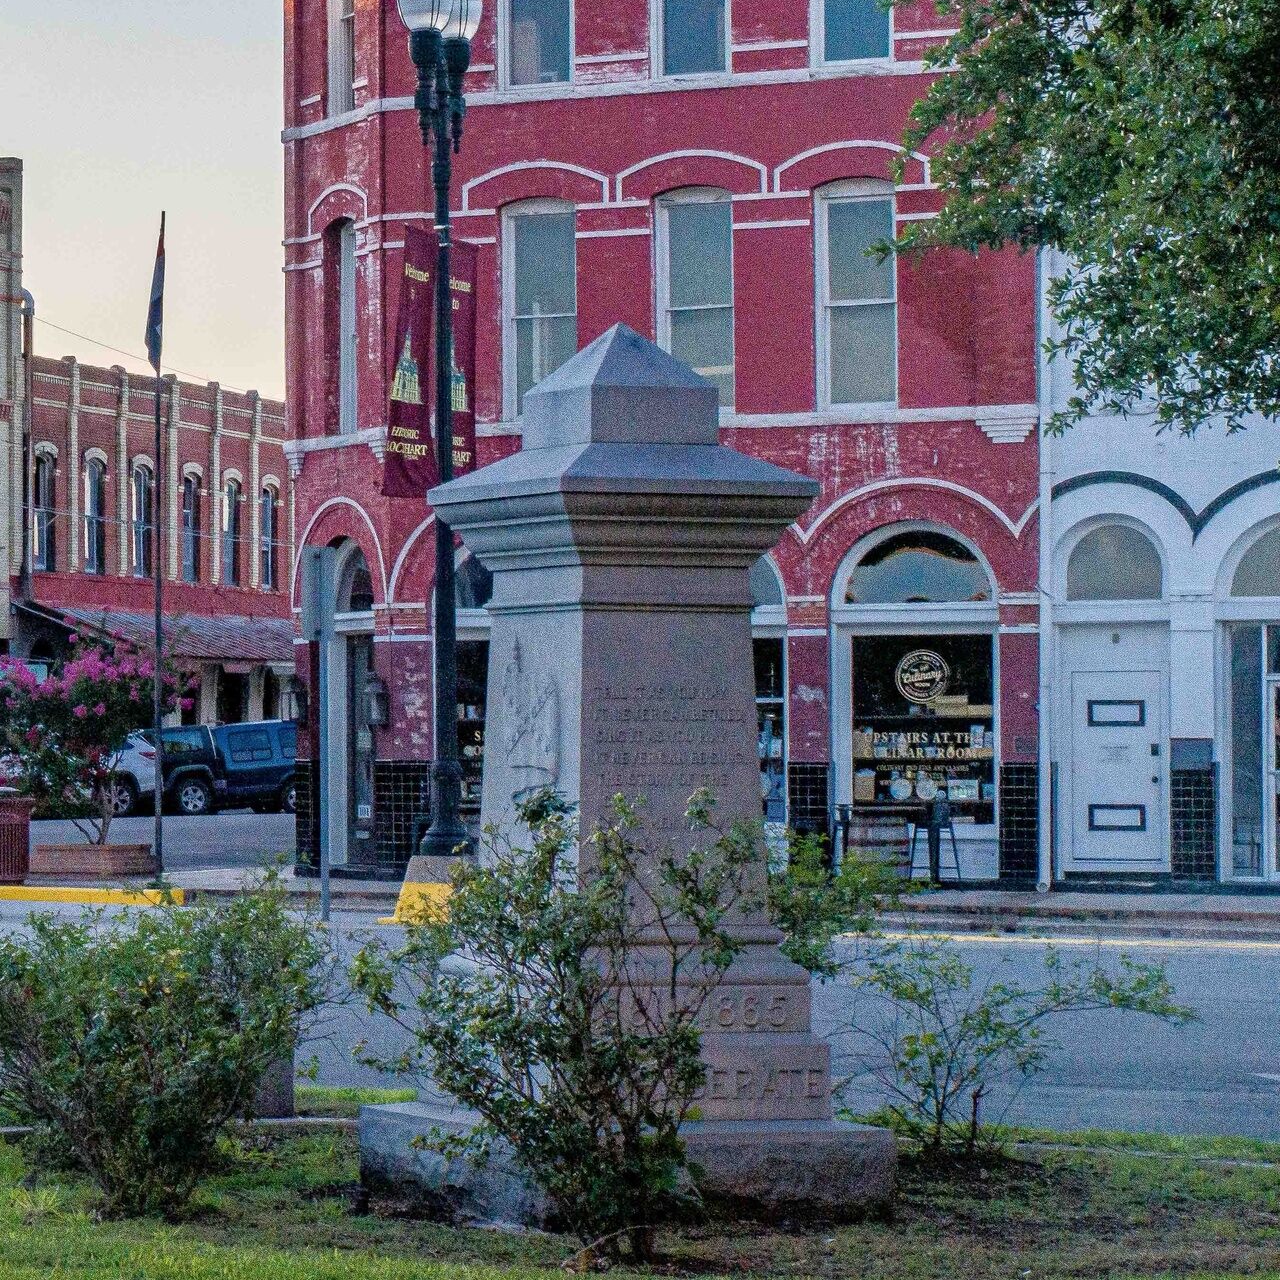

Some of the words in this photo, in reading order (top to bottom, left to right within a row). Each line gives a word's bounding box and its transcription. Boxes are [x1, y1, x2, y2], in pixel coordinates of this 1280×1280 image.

[449, 275, 472, 292] elcome
[452, 298, 460, 310] to
[386, 441, 428, 456] LOCHART
[901, 670, 942, 684] Culinary
[933, 732, 950, 743] AT
[937, 747, 978, 759] ROOM
